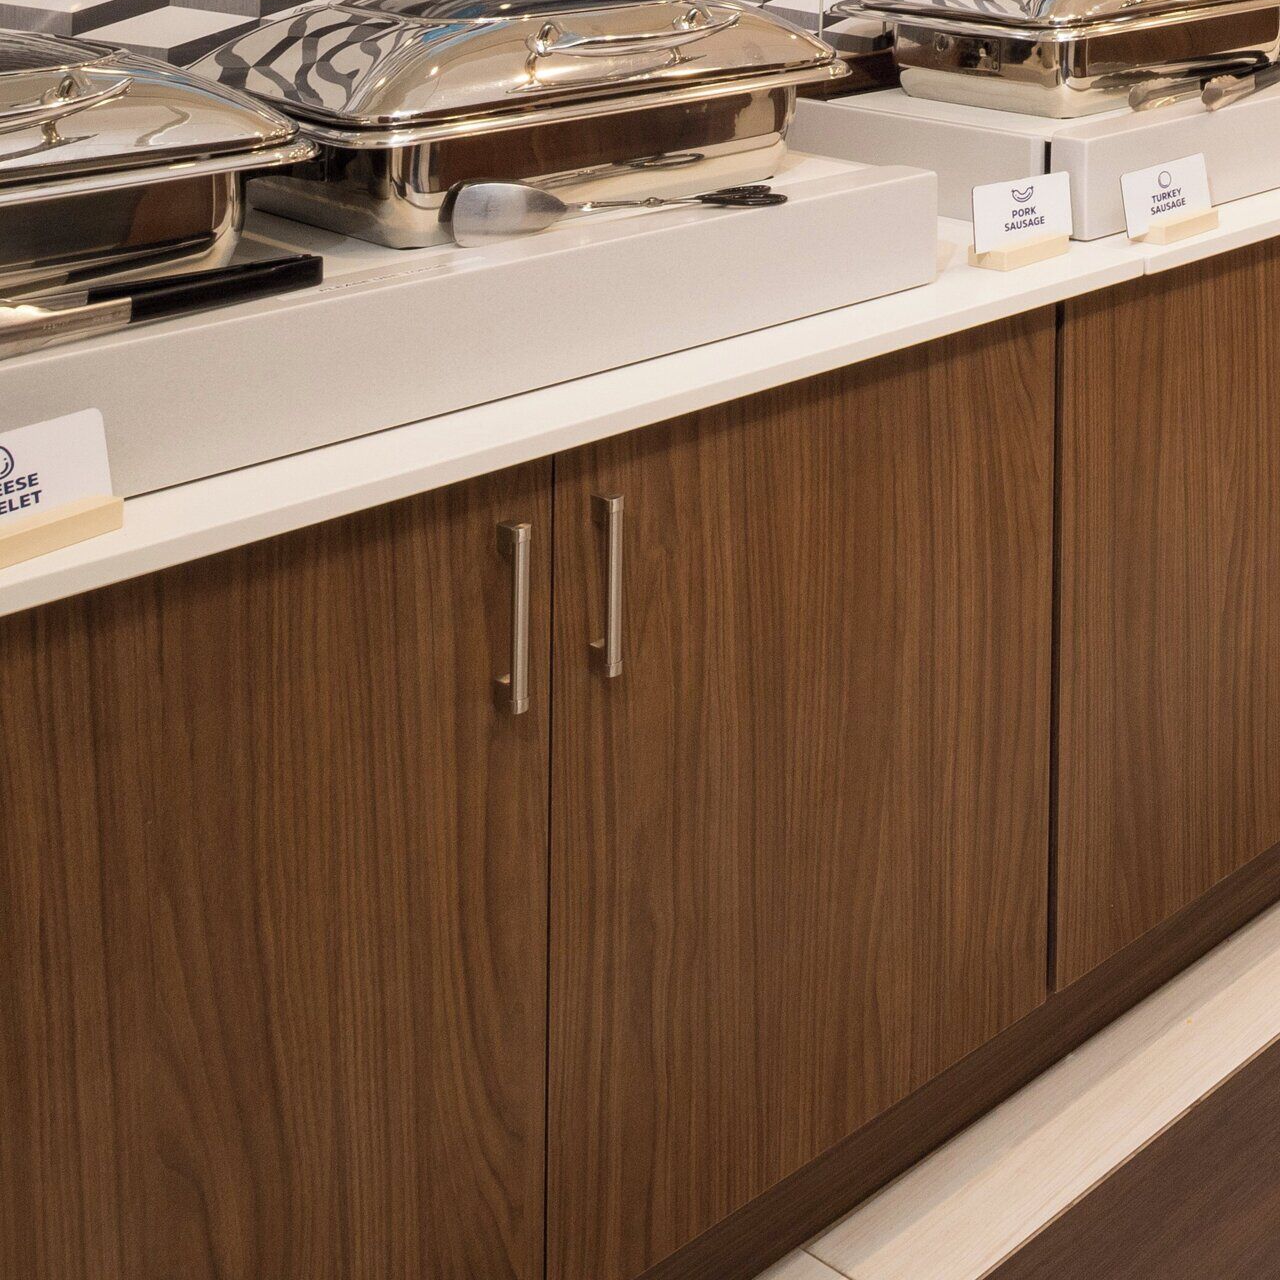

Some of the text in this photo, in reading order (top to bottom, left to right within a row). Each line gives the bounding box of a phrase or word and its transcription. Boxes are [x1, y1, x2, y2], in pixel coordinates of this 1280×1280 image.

[1151, 187, 1182, 204] TURKEY
[1011, 206, 1037, 219] PORK
[1150, 197, 1187, 216] SAUSAGE
[1004, 215, 1046, 232] SAUSAGE
[0, 472, 39, 497] ESE
